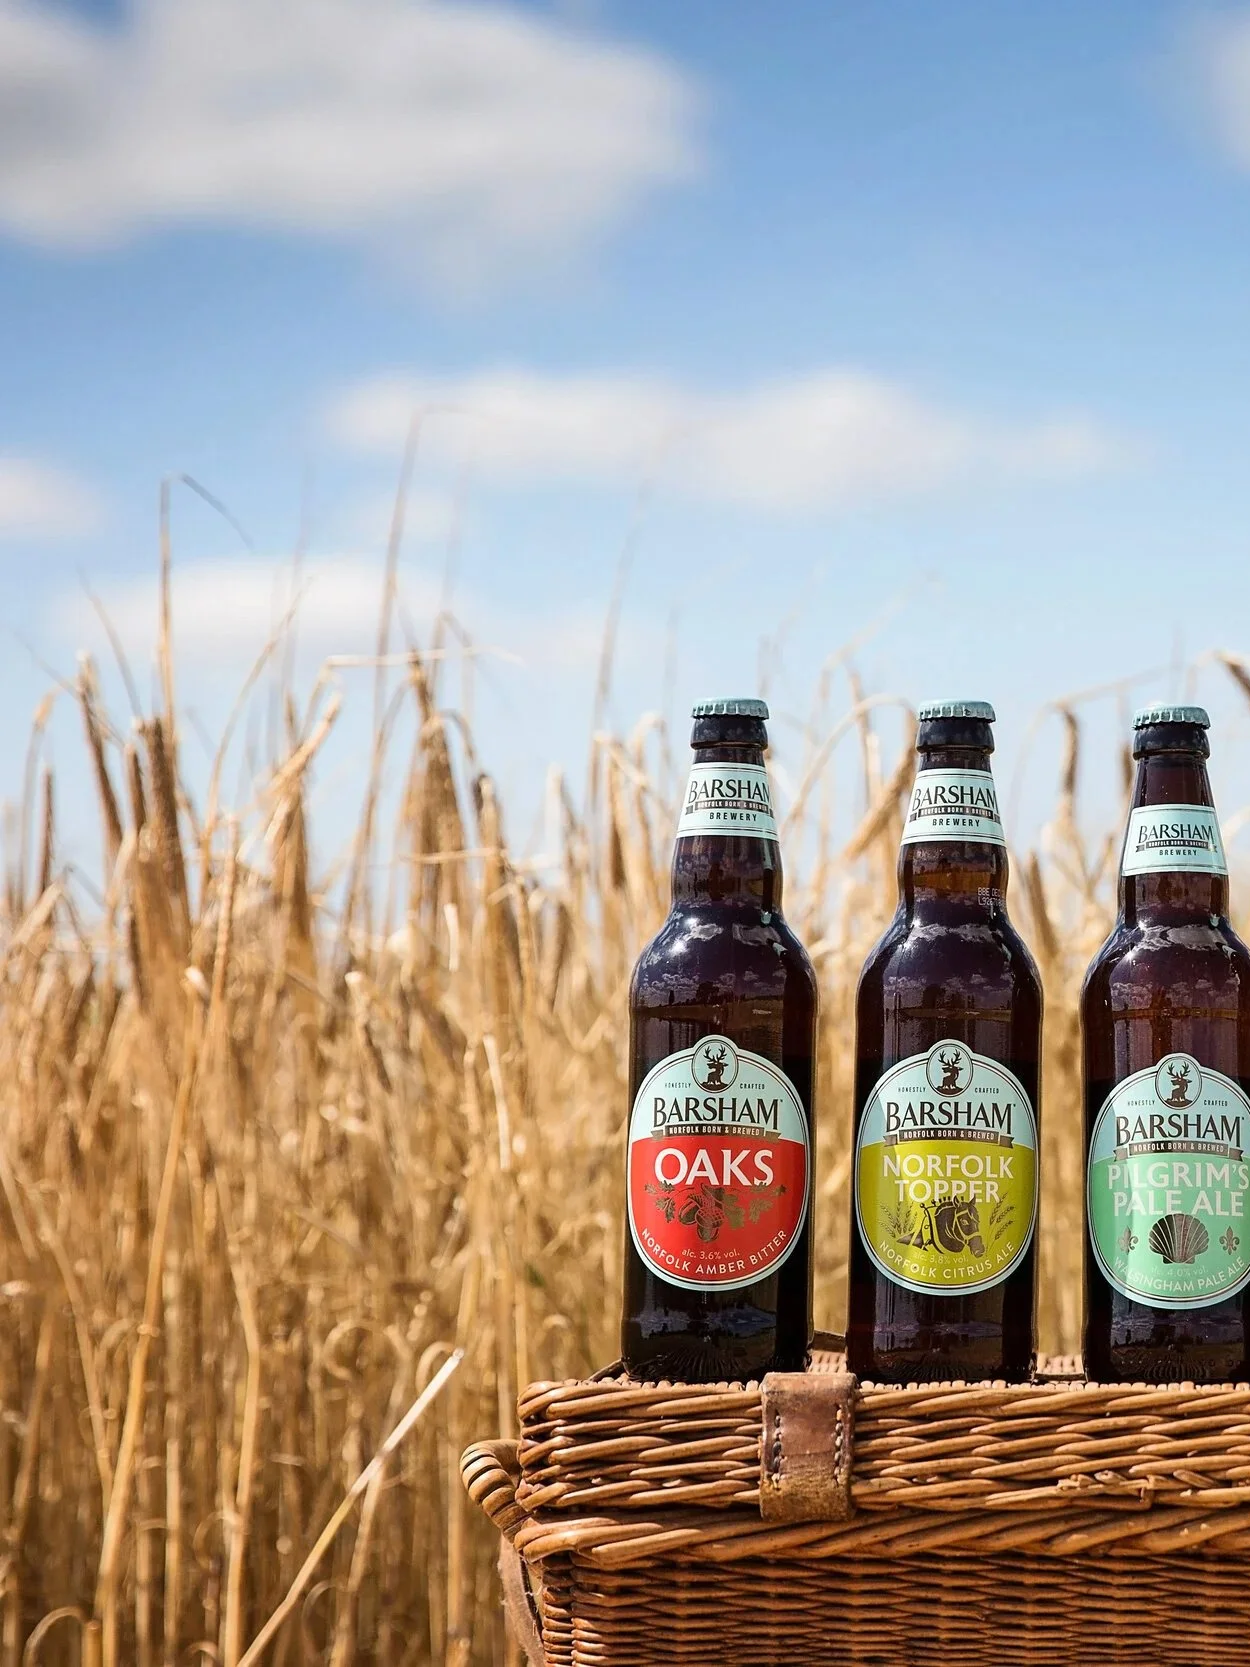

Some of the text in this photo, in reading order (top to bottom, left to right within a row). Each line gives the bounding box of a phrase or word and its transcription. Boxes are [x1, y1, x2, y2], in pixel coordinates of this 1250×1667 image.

[912, 786, 999, 814] BARSHAM
[710, 812, 757, 821] BREWERY
[933, 818, 980, 826] BREWERY
[1138, 824, 1215, 844] BARSHAM
[654, 1098, 778, 1129] BARSHAM
[886, 1102, 1011, 1134] BARSHAM
[670, 1126, 699, 1134] NORFOLK
[733, 1127, 759, 1135] BREWED
[904, 1130, 934, 1139] NORFOLK
[938, 1130, 956, 1138] BORN
[968, 1131, 995, 1140] BREWED
[1116, 1114, 1240, 1147] BARSHAM
[1134, 1143, 1164, 1151] NORFOLK
[1198, 1144, 1223, 1152] BREWED
[655, 1148, 773, 1185] OAKS
[883, 1155, 1013, 1178] NORFOLK
[1108, 1162, 1249, 1189] PILGRIM'S
[895, 1180, 1000, 1203] TOPPER
[1113, 1190, 1243, 1216] PALE ALE
[642, 1228, 787, 1274] NORFOLK AMBER BITTER
[682, 1249, 740, 1260] alc. 3.6% vol.
[879, 1240, 1014, 1278] NORFOLK CITRUS ALE
[1114, 1257, 1245, 1292] WALSINGHAM PALE ALE
